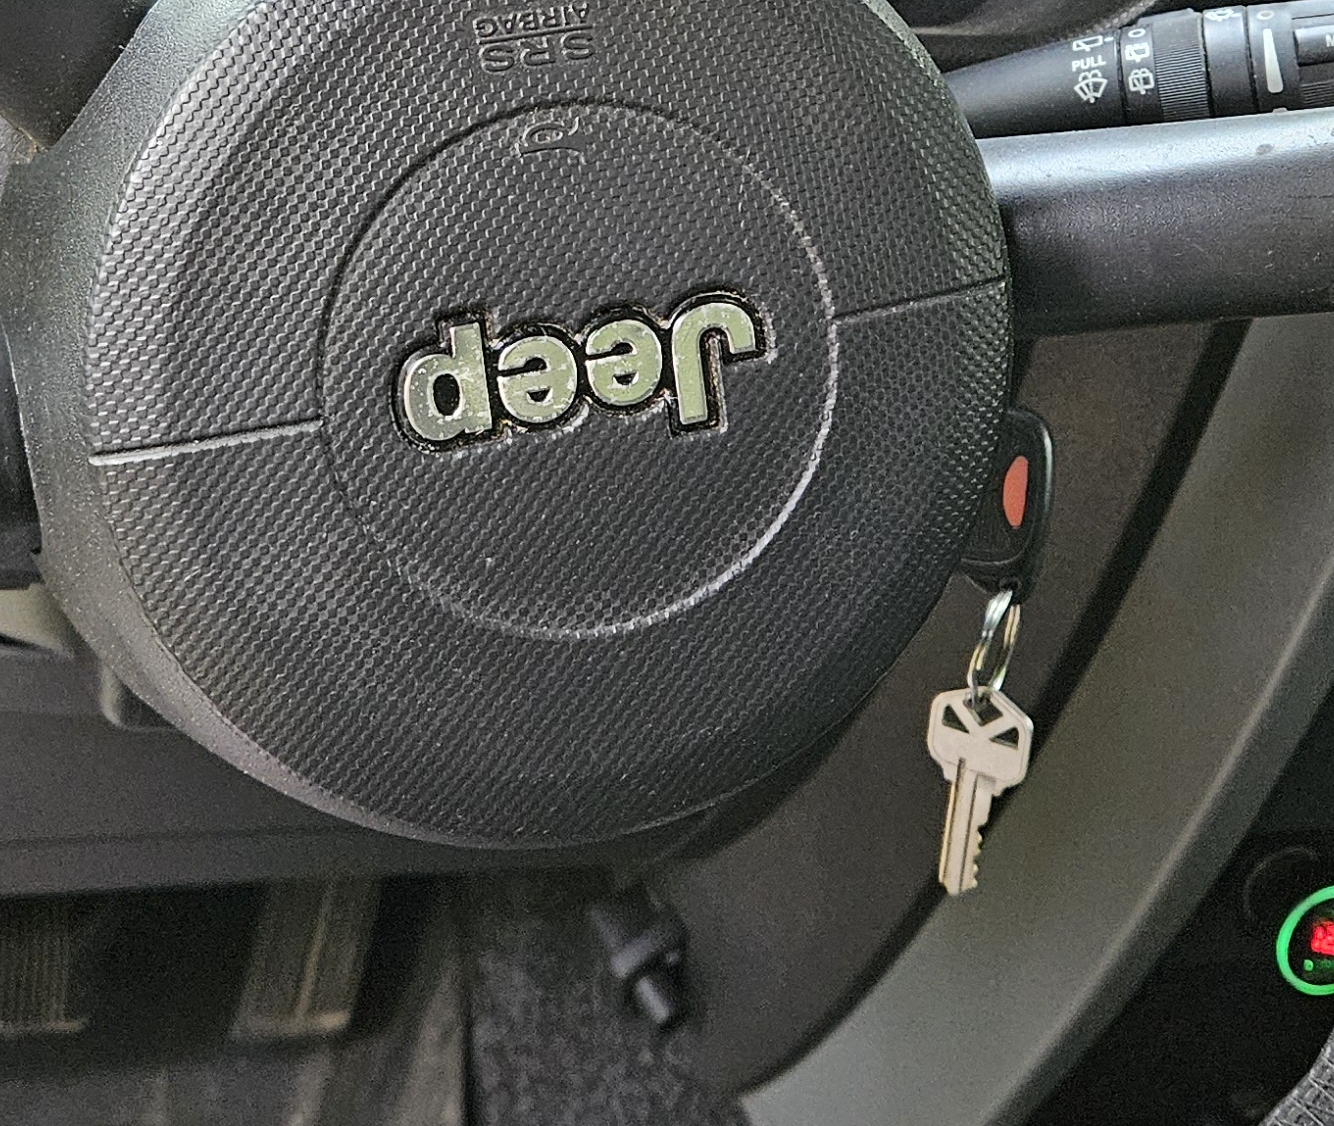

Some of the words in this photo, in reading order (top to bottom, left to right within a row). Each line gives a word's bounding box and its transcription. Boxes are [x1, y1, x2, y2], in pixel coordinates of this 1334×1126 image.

[473, 3, 589, 38] AIRBAG
[479, 31, 596, 73] SRS
[1072, 55, 1106, 72] PULL
[404, 302, 757, 442] Jeep
